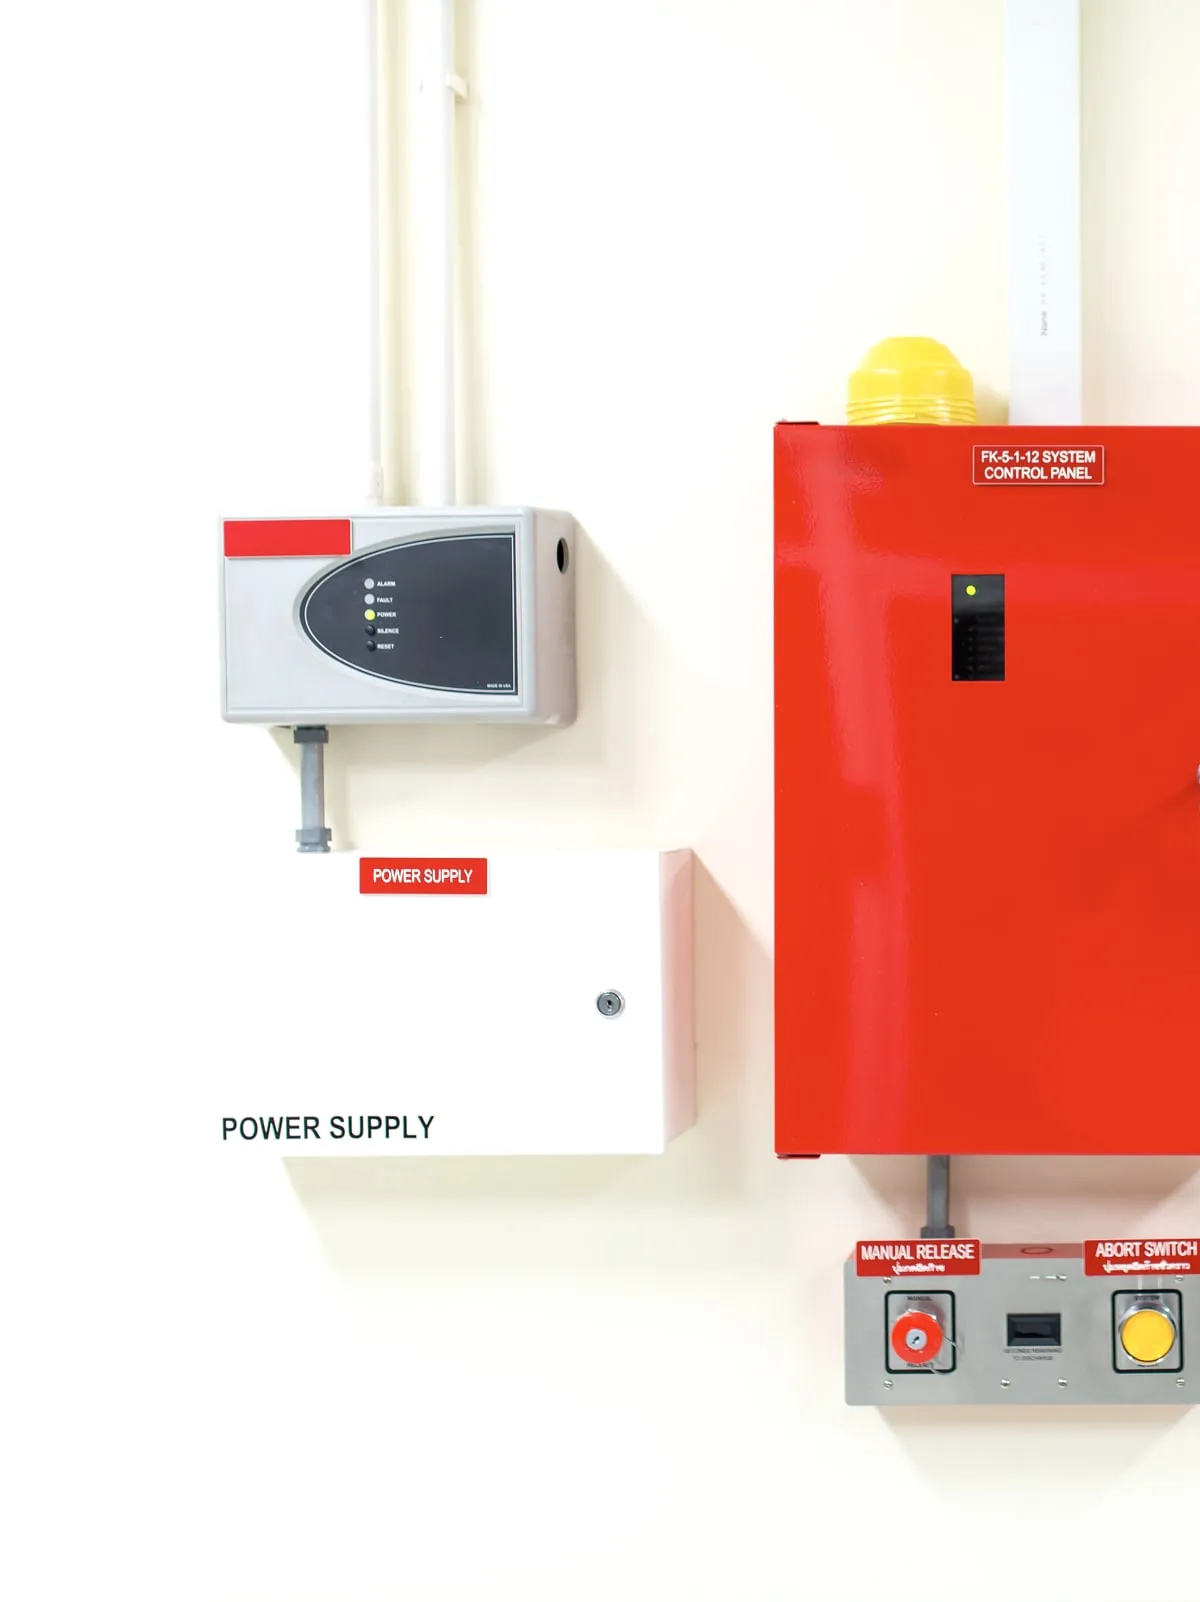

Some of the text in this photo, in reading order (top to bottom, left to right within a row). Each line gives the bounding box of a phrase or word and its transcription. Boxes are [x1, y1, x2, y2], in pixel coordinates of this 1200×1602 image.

[981, 450, 1096, 463] FK-5-1-12 SYSTEM
[984, 466, 1092, 479] CONTROL PANEL
[373, 868, 473, 883] POWER SUPPLY
[222, 1115, 435, 1140] POWER SUPPLY
[861, 1244, 975, 1260] MANUAL RELEASE
[1095, 1241, 1198, 1257] ABORT SWITCH
